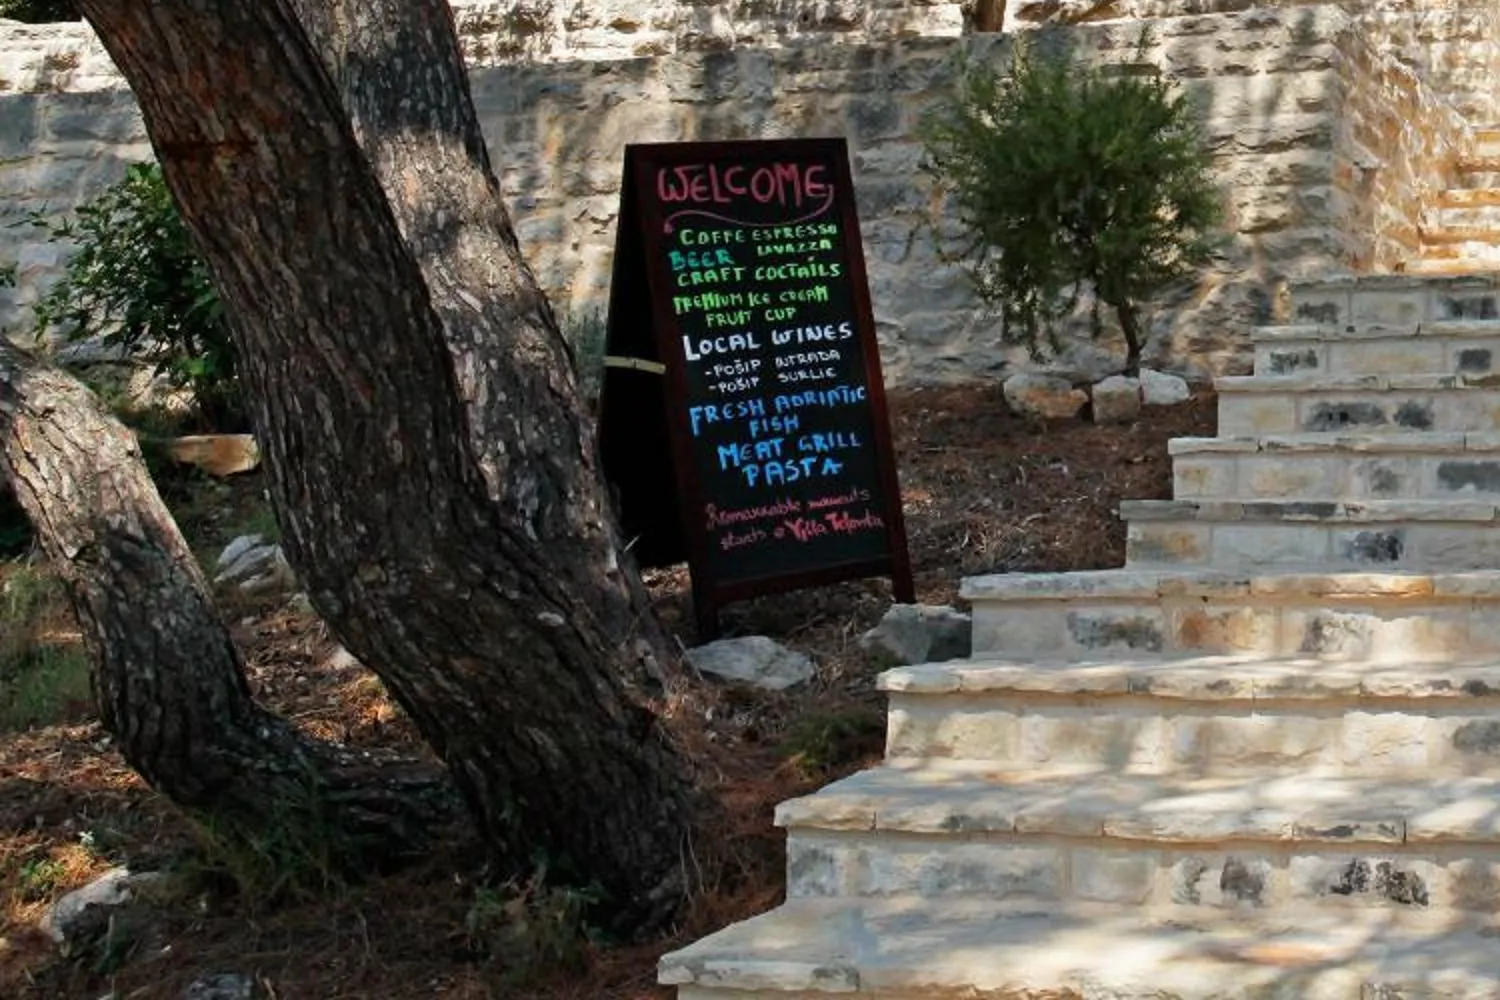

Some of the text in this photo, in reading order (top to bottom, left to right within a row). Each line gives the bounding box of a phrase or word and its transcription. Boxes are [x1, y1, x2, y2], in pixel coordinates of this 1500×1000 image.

[657, 161, 829, 208] WELCOME
[679, 223, 839, 246] COFFE ESPRESSO
[668, 248, 735, 271] BEER
[757, 239, 832, 257] LAVAZZA
[677, 267, 747, 287] CRAFT
[672, 285, 830, 315] PREMIUM ICE CREAM
[705, 307, 797, 328] FRUIT CUP
[682, 321, 853, 362] LOCAL WINES
[688, 384, 867, 437] FRESH ADRIATIC
[749, 414, 800, 439] FISH
[717, 431, 862, 472] MEAT GRILL
[742, 456, 843, 488] PASTA
[784, 516, 827, 542] Villa
